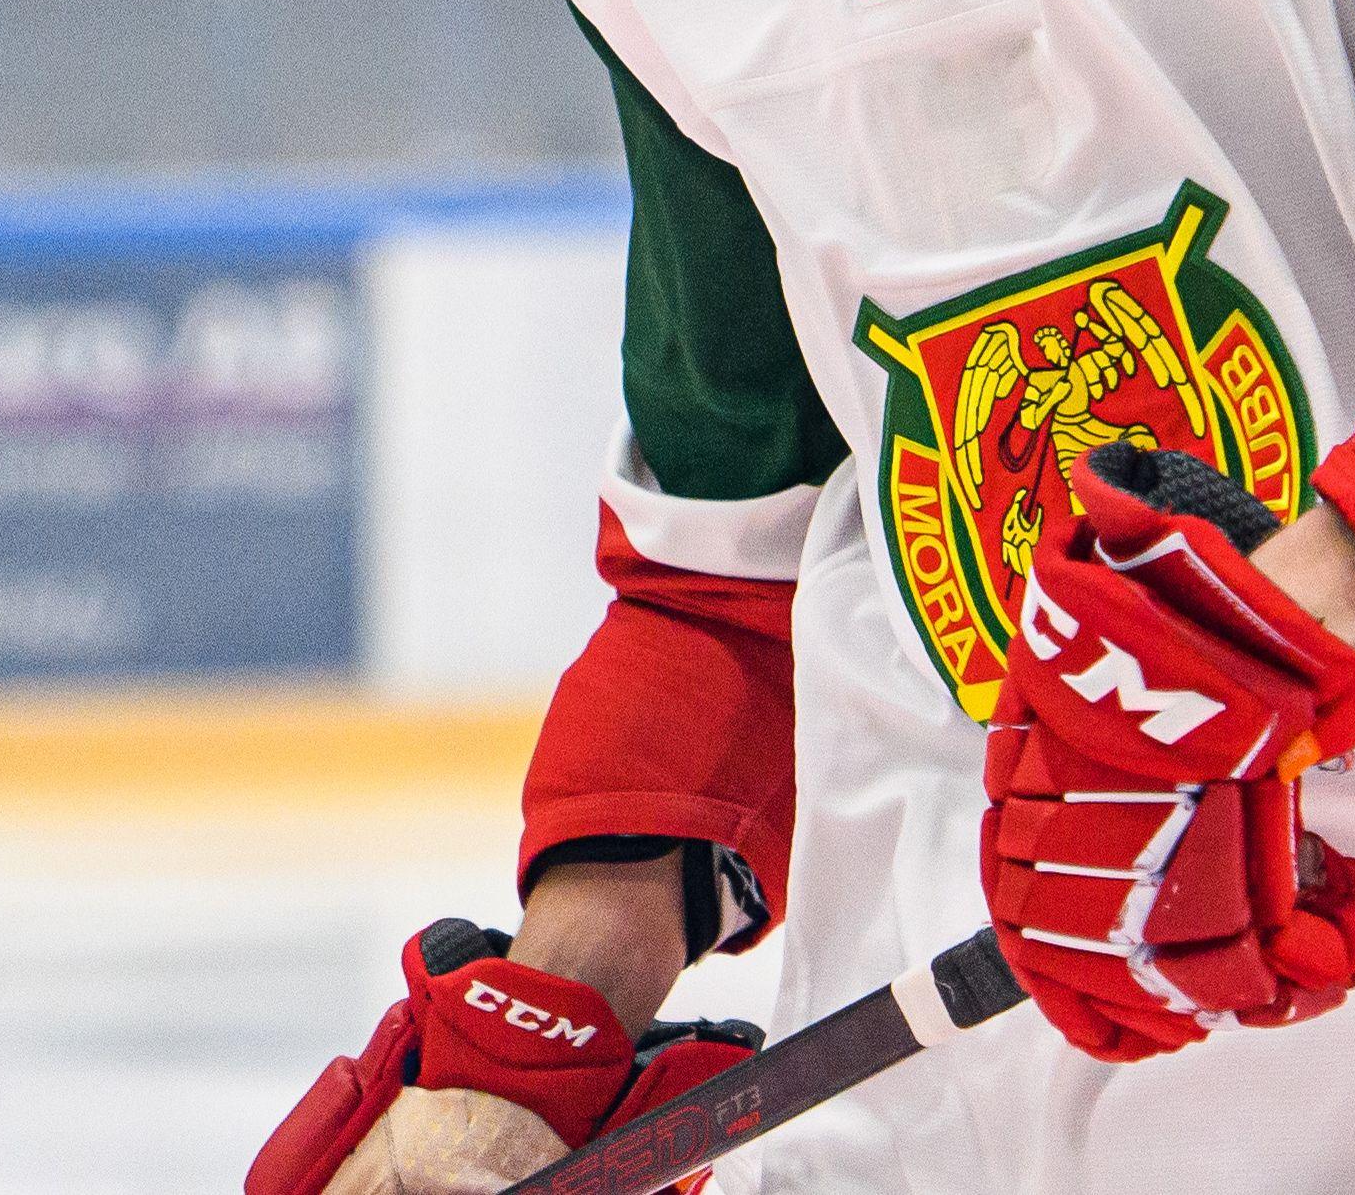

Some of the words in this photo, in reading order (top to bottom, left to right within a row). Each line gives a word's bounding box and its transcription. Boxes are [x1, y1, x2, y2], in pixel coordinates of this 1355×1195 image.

[898, 482, 978, 678] MORA
[463, 979, 598, 1048] CCM
[715, 1083, 762, 1125] FT3
[510, 1104, 709, 1195] EED
